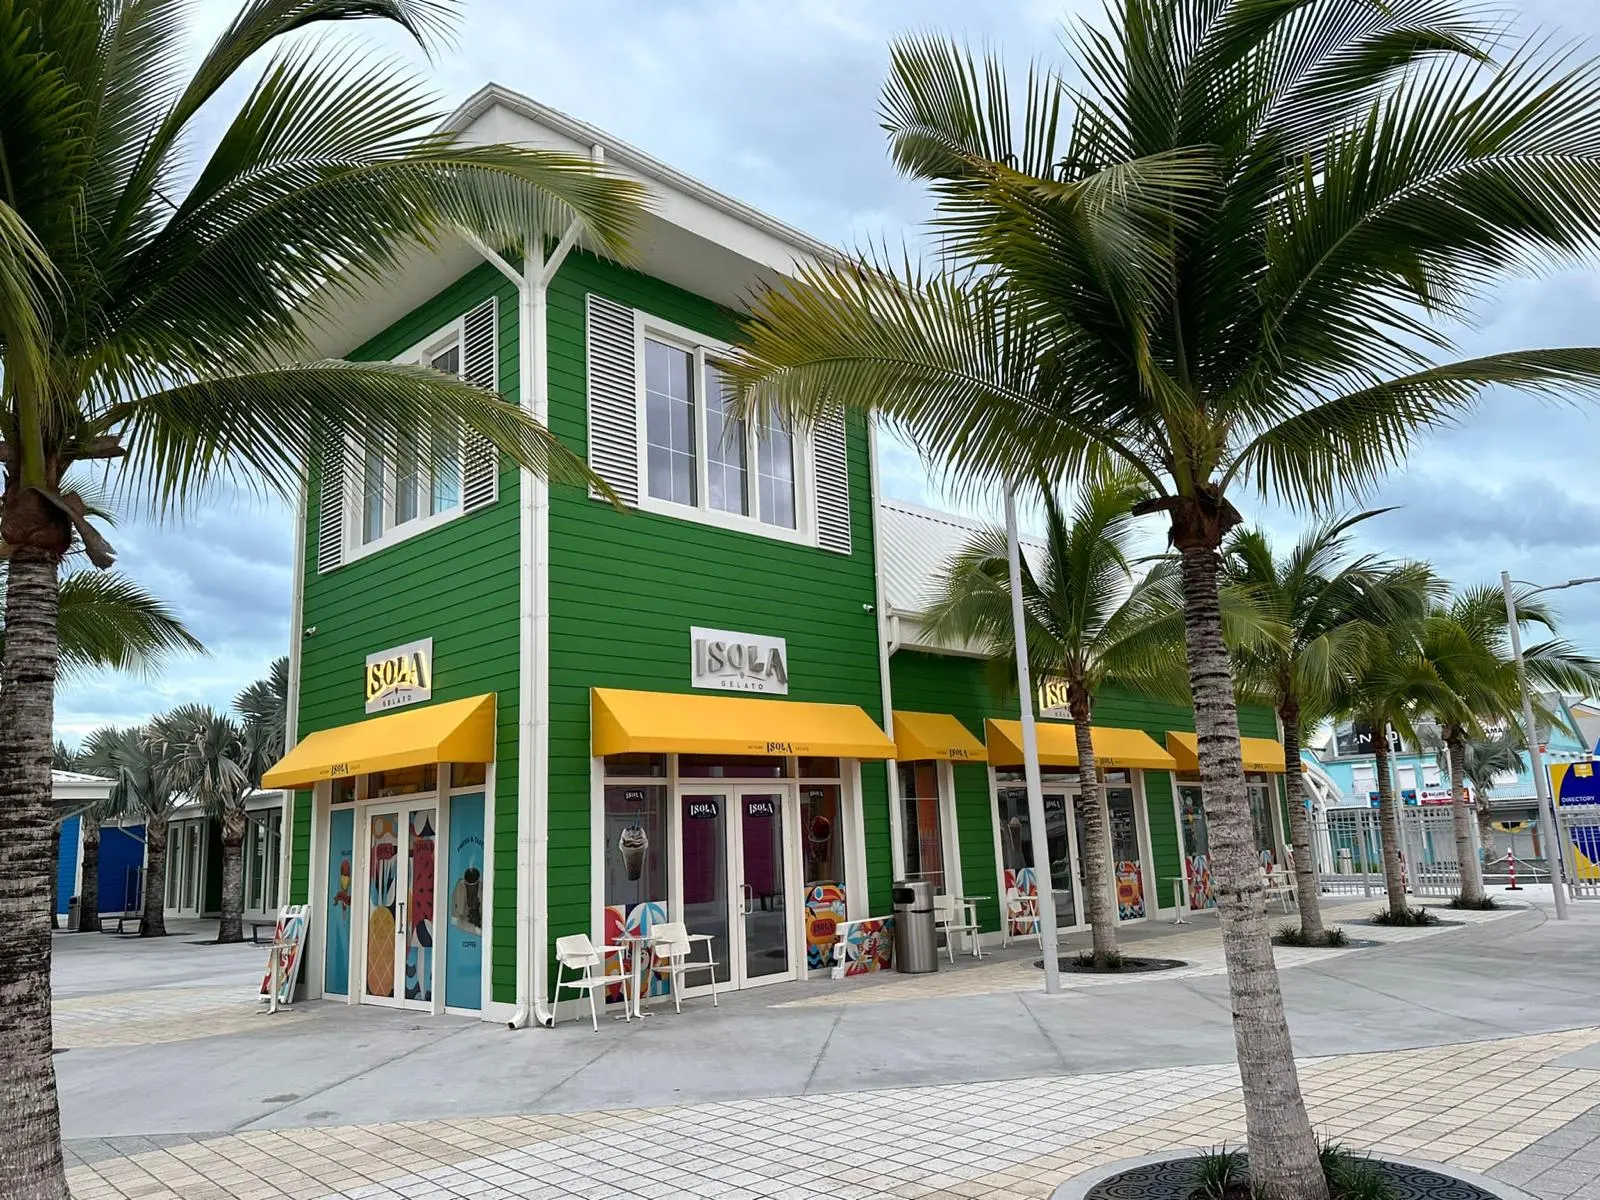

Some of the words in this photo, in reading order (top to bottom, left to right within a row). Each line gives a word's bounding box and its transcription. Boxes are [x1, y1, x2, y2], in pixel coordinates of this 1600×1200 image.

[694, 638, 788, 686] ISOLA
[364, 650, 428, 702] ISOLA
[721, 680, 764, 690] GELATO
[382, 695, 412, 707] GELATO
[766, 741, 792, 754] ISOLA
[331, 762, 349, 777] ISOLA
[1561, 795, 1596, 804] DIRECTORY
[689, 803, 717, 816] ISOLA
[749, 802, 773, 815] ISOLA
